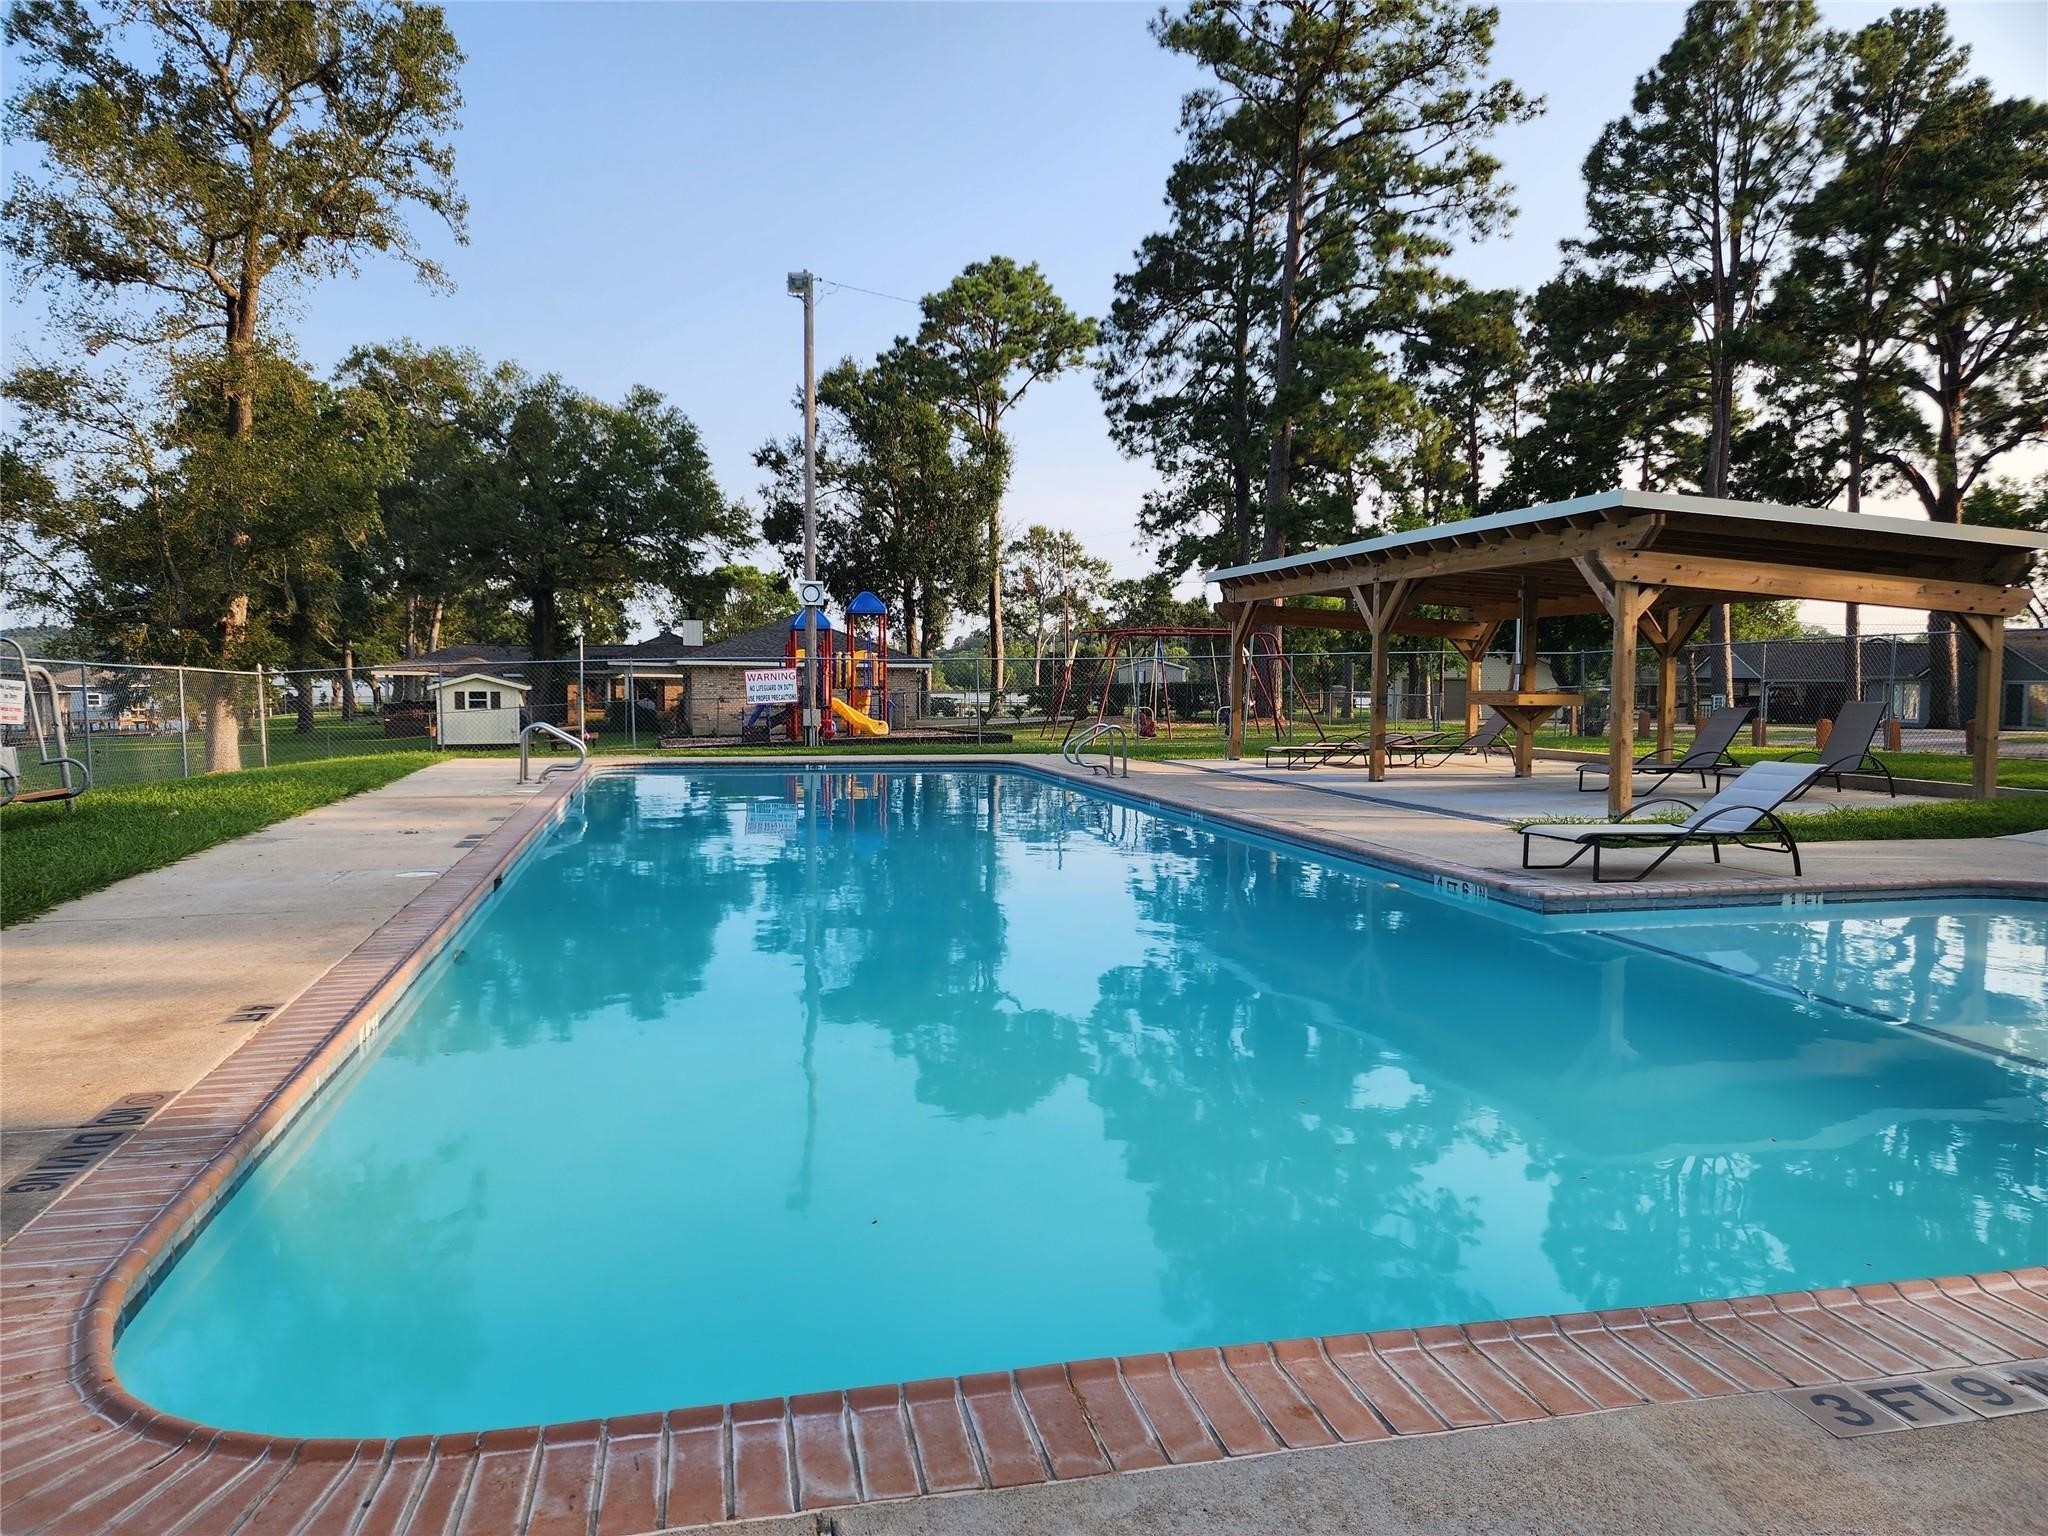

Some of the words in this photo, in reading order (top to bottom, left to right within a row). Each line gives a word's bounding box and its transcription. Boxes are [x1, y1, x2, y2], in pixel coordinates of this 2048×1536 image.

[747, 672, 796, 681] WARNING
[756, 684, 776, 692] LIFEGUARD
[783, 683, 793, 691] DUTY
[756, 694, 770, 702] PROPER
[771, 693, 797, 701] PRECAUTIONS
[95, 1106, 154, 1124] NO
[4, 1132, 126, 1194] DIVING
[1810, 1393, 1875, 1427] 3
[1864, 1384, 1959, 1422] FT
[1951, 1374, 2014, 1407] 9
